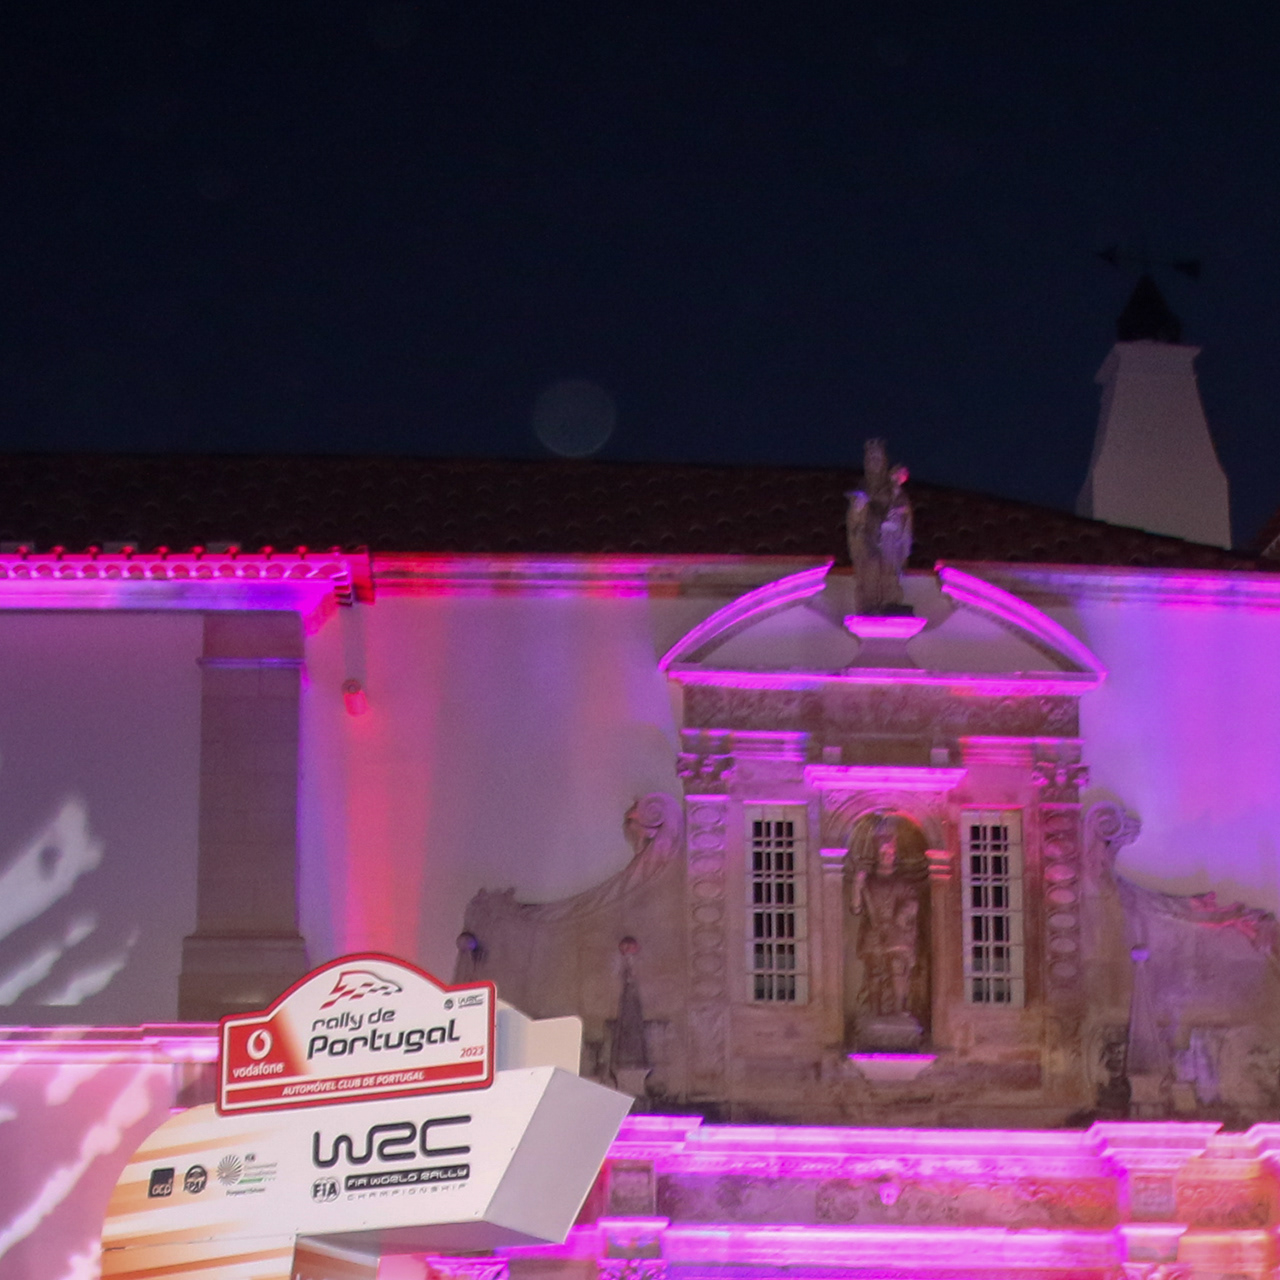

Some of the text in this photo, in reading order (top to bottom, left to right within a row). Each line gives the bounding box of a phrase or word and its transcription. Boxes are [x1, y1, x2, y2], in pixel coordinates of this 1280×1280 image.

[312, 1007, 396, 1032] rally de
[307, 1018, 461, 1061] Portugal
[460, 1047, 485, 1058] 2023
[232, 1061, 284, 1079] vodafone
[337, 1078, 361, 1091] CLUB
[363, 1076, 375, 1087] DE
[376, 1071, 426, 1086] PORTUGAL
[312, 1114, 472, 1169] WRC
